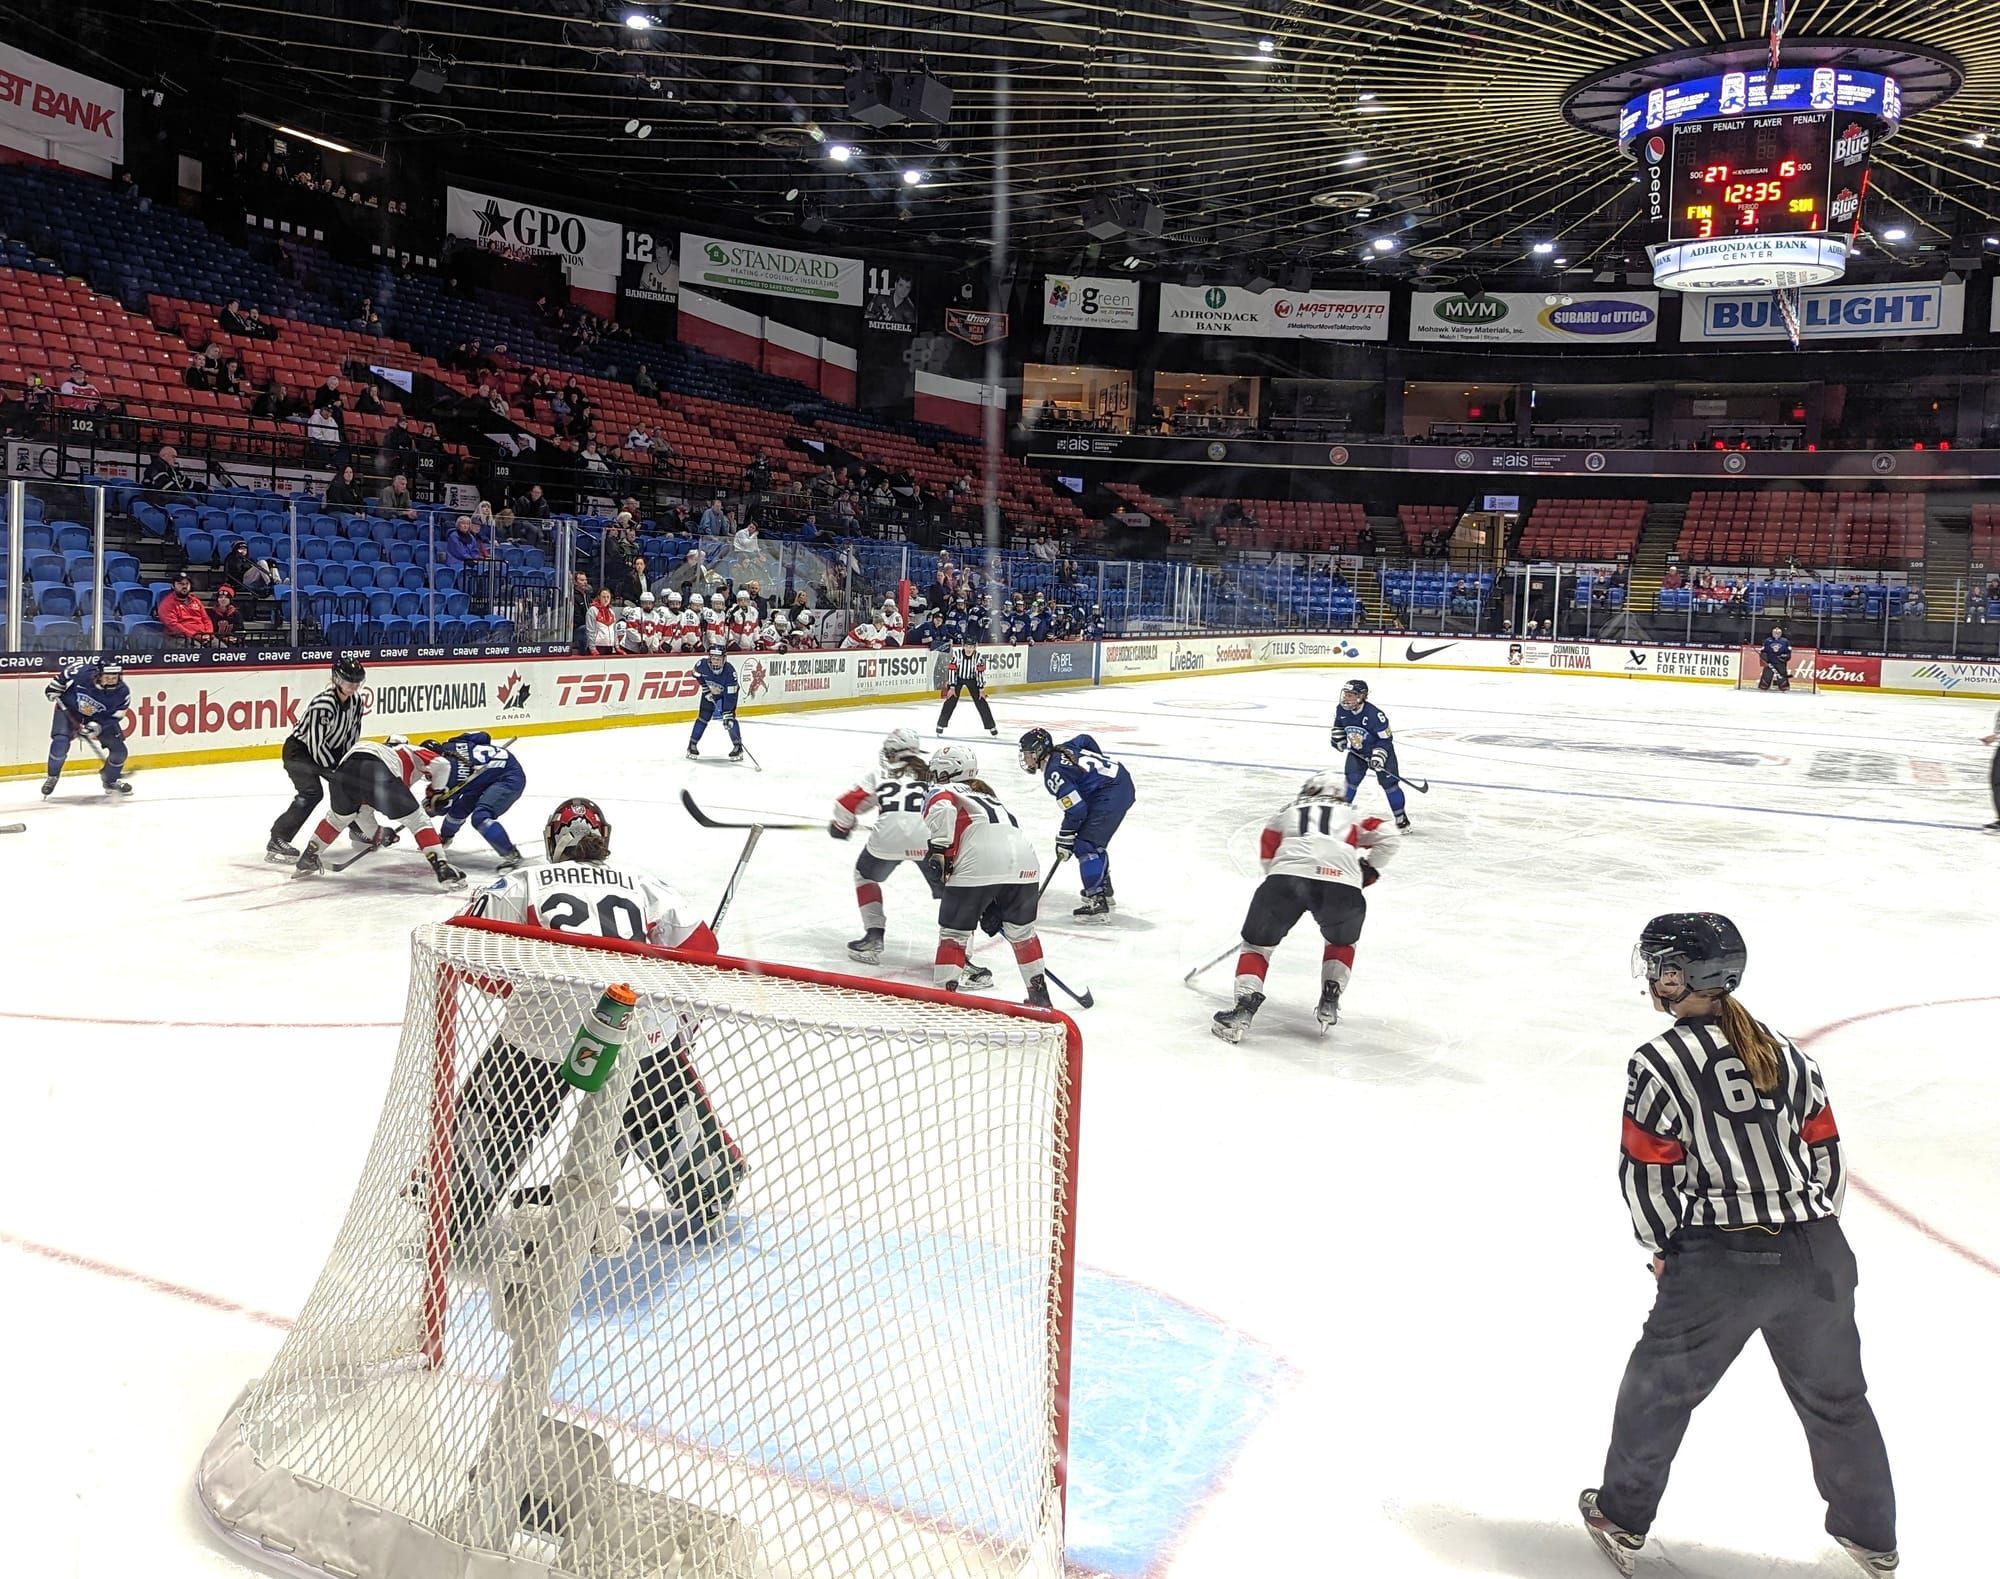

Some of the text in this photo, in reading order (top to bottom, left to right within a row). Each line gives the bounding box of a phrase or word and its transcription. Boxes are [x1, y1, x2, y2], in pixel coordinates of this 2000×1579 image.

[0, 70, 115, 138] BT BANK
[1675, 114, 1827, 134] PLAYER PENALTY PLAYER PENALTY
[1835, 136, 1869, 160] Blue
[1690, 171, 1703, 180] SOG
[1705, 166, 1728, 182] 27
[1780, 161, 1796, 177] 15
[1797, 163, 1812, 172] SOG
[1648, 166, 1662, 222] pepsi
[1724, 182, 1781, 203] 12:35
[1687, 205, 1712, 219] FIN
[1831, 198, 1859, 217] Blue
[513, 207, 586, 254] GPO
[1699, 219, 1712, 238] 3
[1742, 210, 1754, 225] 3
[626, 231, 654, 263] 12
[1690, 238, 1808, 257] ADIRONDACK BANK
[1723, 250, 1773, 261] CENTER
[731, 248, 839, 279] STANDARD
[731, 268, 839, 288] HEATING COOLING INSULATING
[868, 267, 891, 296] 11
[625, 288, 676, 304] BANNERMAN
[1069, 287, 1130, 315] pjgreen
[1171, 309, 1259, 322] ADIRONDACK
[1295, 311, 1383, 320] HYUNDAI
[1298, 303, 1385, 314] MASTROVITO
[1445, 302, 1497, 317] MVM
[1553, 310, 1647, 324] SUBARU of UTICA
[1806, 296, 1927, 325] LIGHT
[868, 320, 913, 333] MITCHELL
[1196, 322, 1232, 332] BANK
[1451, 326, 1473, 334] Valley
[1474, 327, 1512, 335] Materials,
[71, 419, 94, 432] 102
[1068, 435, 1090, 451] ais
[420, 458, 434, 468] 102
[1505, 451, 1529, 467] ais
[496, 466, 509, 476] 103
[416, 491, 429, 500] 203
[1216, 644, 1253, 663] Scotiabank
[1272, 642, 1331, 656] TELUS Stream+
[1553, 644, 1590, 655] COMING TO
[769, 660, 782, 676] MAY
[797, 659, 812, 675] 2024
[814, 658, 839, 674] CALGARY,
[838, 658, 846, 673] AB
[878, 656, 928, 677] TISSOT
[982, 653, 1022, 671] TISSOT
[1061, 653, 1073, 667] BFL
[1169, 651, 1204, 672] LiveBarn
[1549, 654, 1592, 670] OTTAWA
[1657, 651, 1730, 666] EVERYTHING
[1656, 664, 1729, 678] FOR THE GIRLS
[1793, 660, 1866, 683] Hortons
[1964, 676, 2000, 684] HOSPITA
[637, 670, 701, 700] RDS
[785, 677, 830, 692] HOCKEYCANADA.CA
[120, 687, 302, 741] otiabank
[495, 712, 531, 721] CANADA
[1362, 716, 1369, 726] C
[1047, 771, 1065, 794] 22
[877, 781, 929, 813] 22
[1298, 805, 1332, 836] 11
[540, 867, 634, 890] BRAENDLI
[541, 893, 647, 943] 20
[570, 1036, 604, 1077] G
